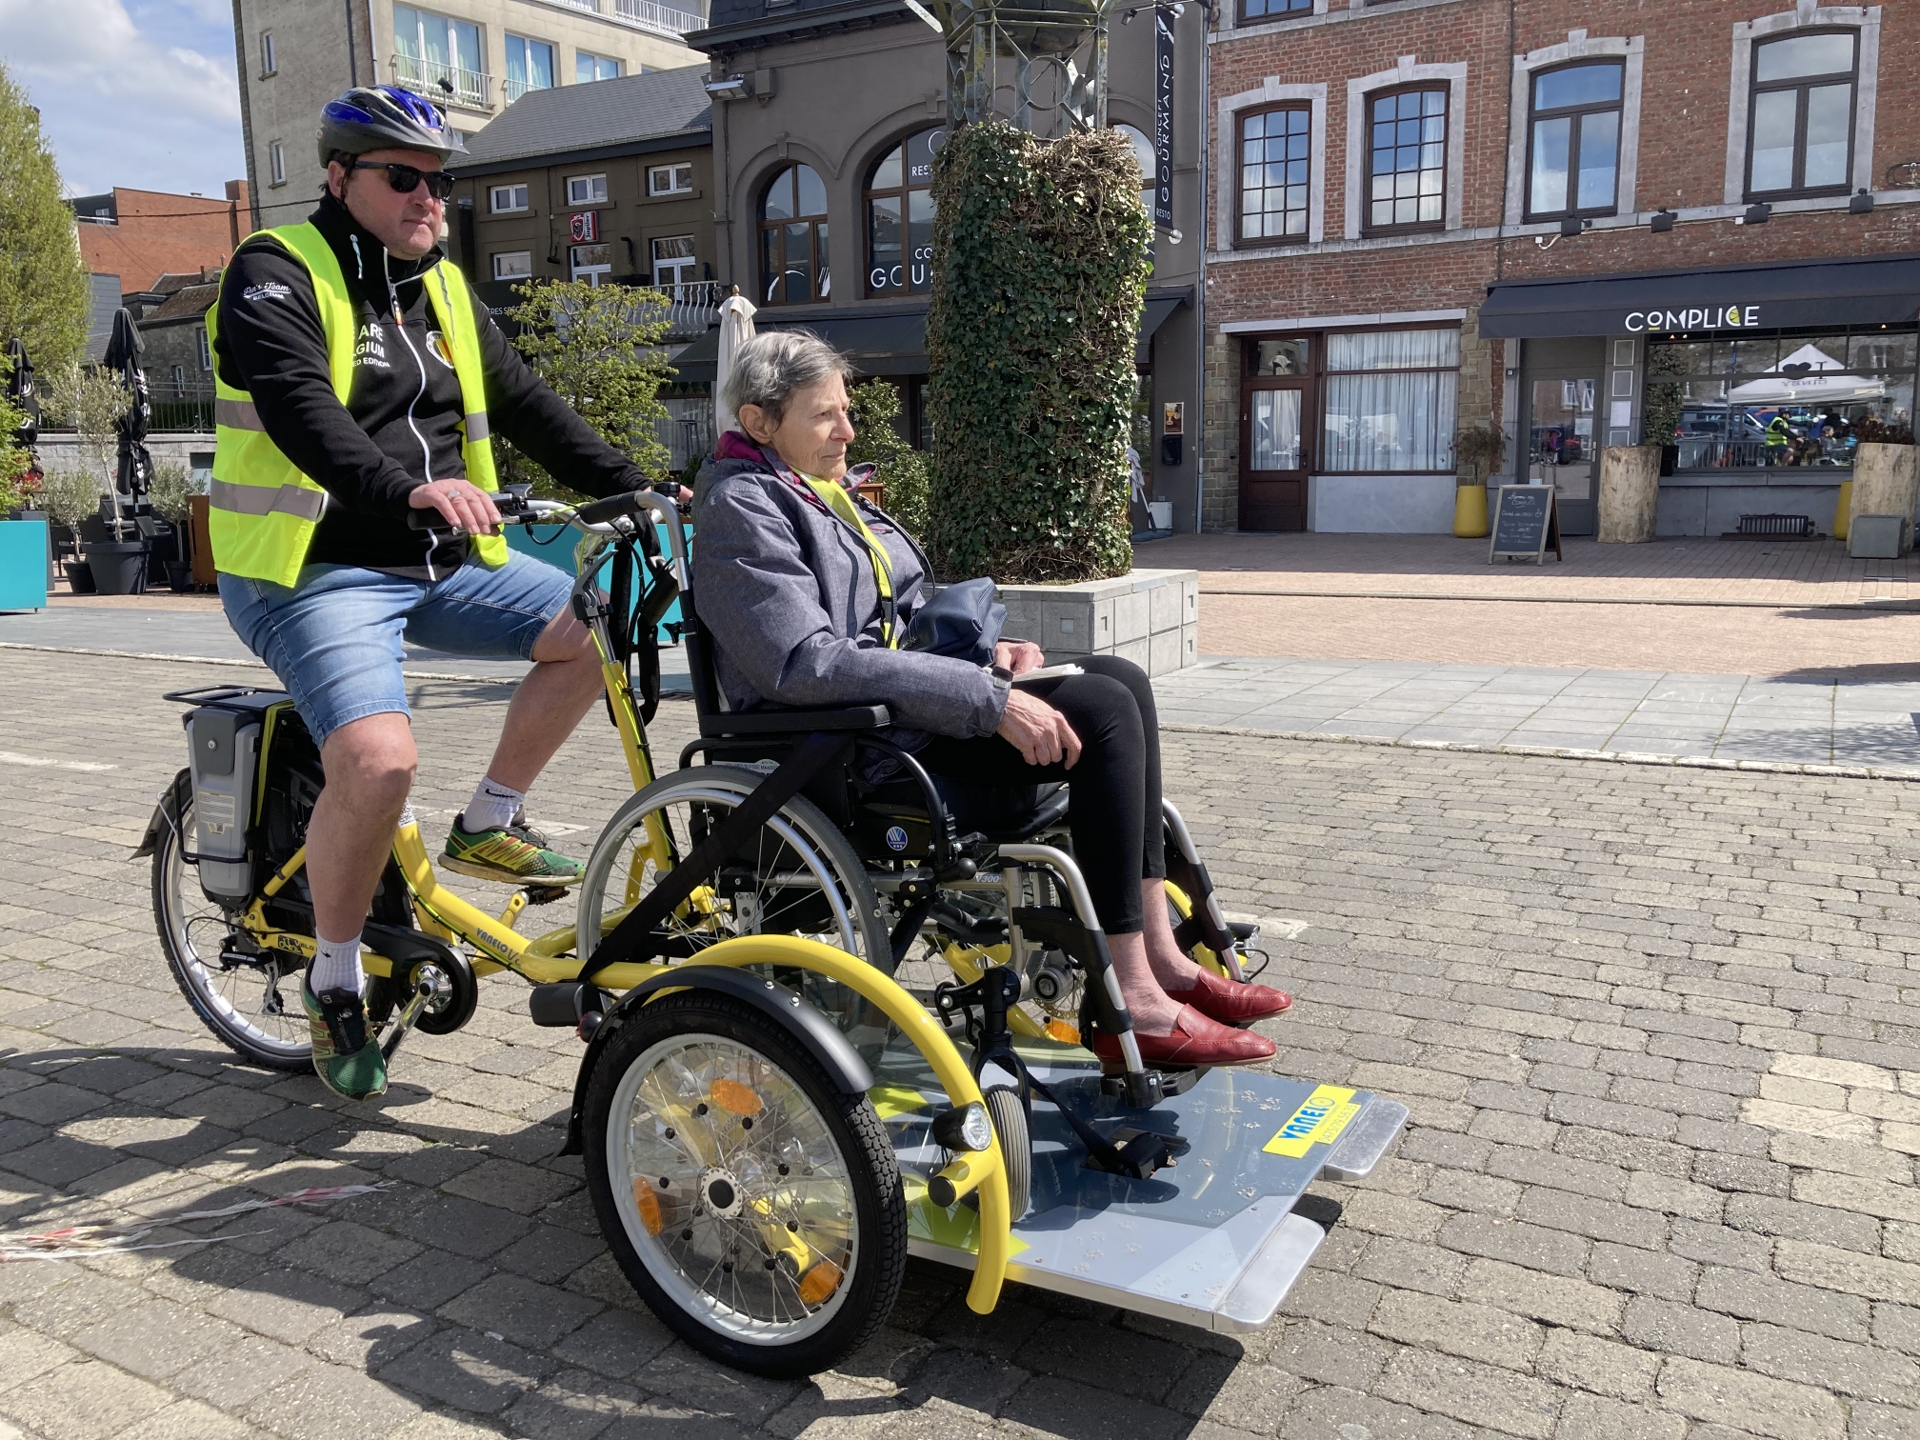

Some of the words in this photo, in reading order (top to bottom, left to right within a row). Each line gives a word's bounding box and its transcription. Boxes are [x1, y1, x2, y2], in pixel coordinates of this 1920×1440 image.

[1162, 54, 1170, 202] GOURMAND
[911, 164, 931, 176] RES
[1156, 207, 1171, 219] RESTO
[1624, 305, 1760, 332] COMPLICE
[363, 357, 391, 367] EDITION
[975, 875, 999, 883] V300
